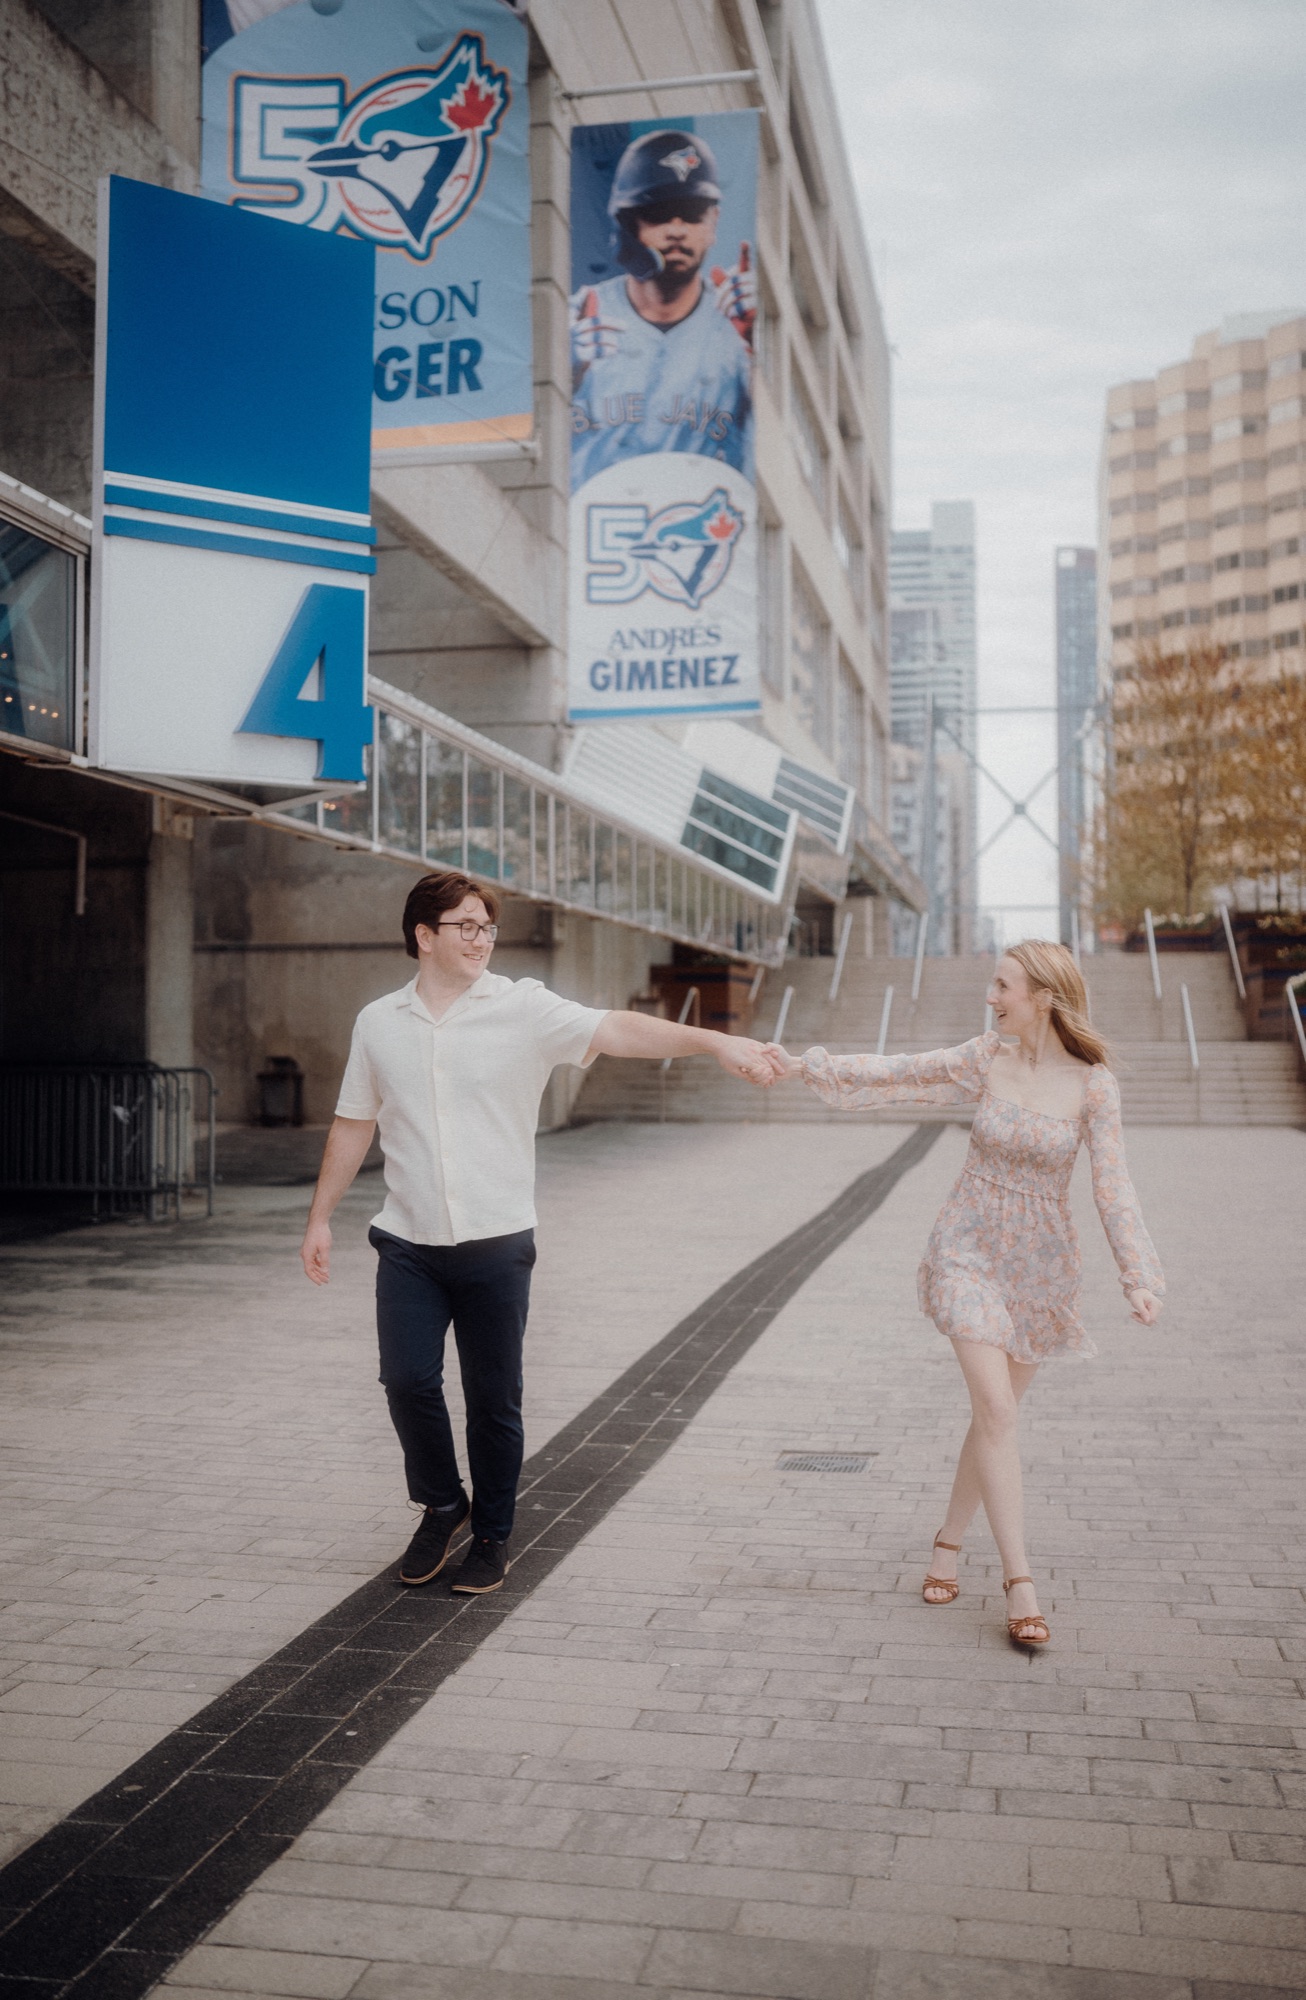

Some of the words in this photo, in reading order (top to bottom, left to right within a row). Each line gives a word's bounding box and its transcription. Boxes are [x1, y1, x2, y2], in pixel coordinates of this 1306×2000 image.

[375, 280, 481, 330] SON
[374, 338, 483, 402] GER
[570, 393, 643, 433] BUE
[661, 394, 733, 441] JAYS
[233, 583, 374, 782] 4
